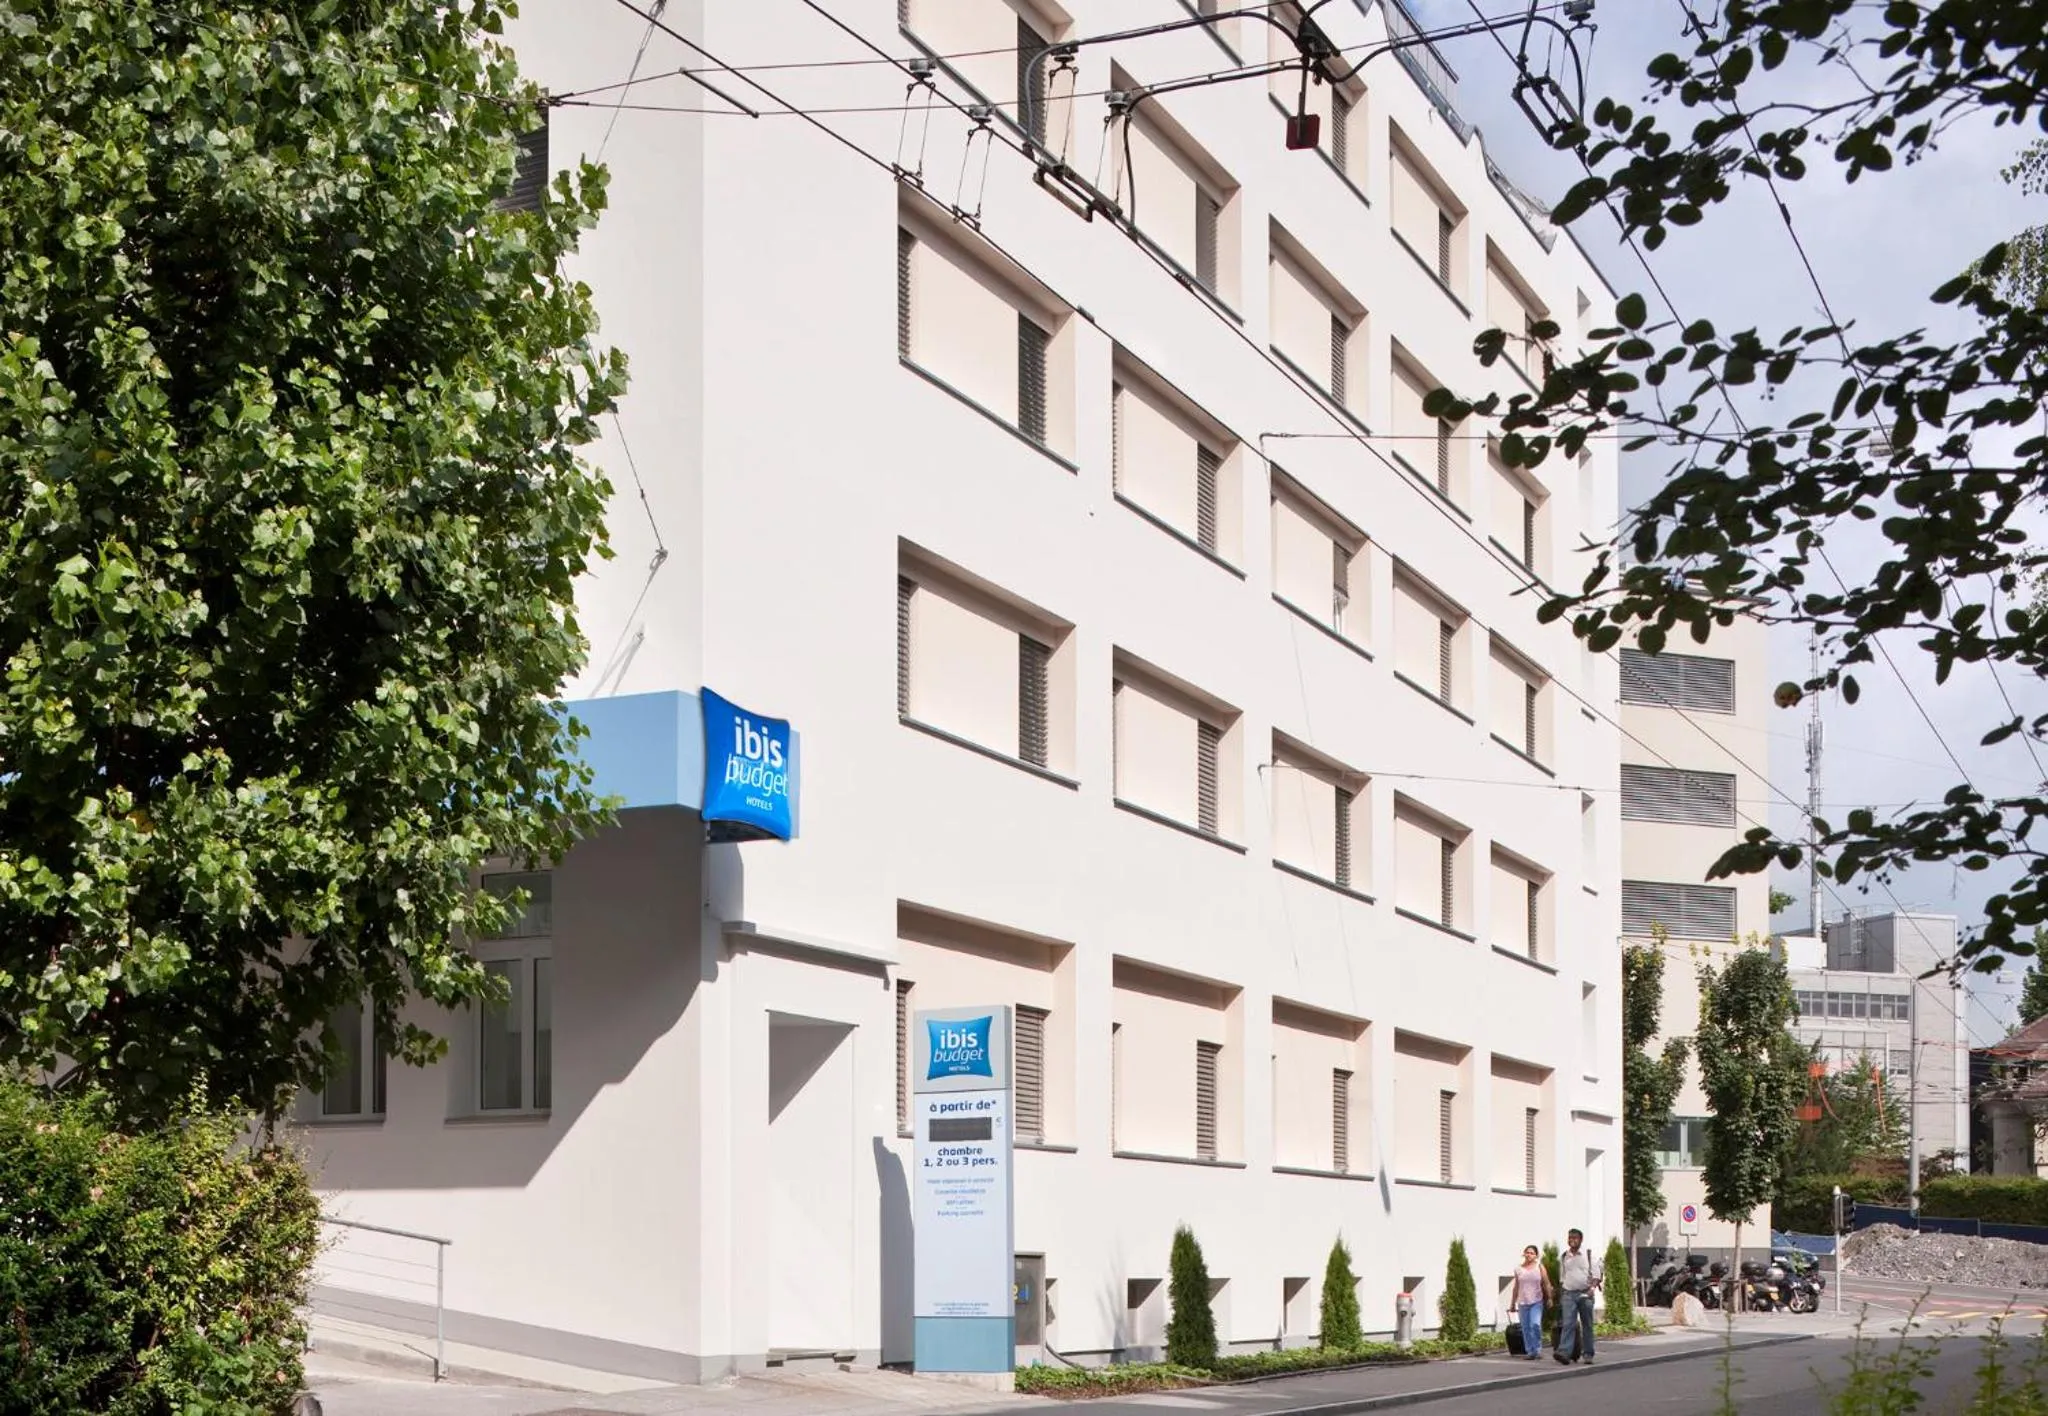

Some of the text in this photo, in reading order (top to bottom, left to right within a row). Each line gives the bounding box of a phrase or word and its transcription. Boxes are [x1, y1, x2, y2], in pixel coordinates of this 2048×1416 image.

[735, 716, 783, 768] ibis
[725, 753, 789, 797] budget
[746, 796, 773, 810] HOTELS
[940, 1028, 978, 1049] ibis
[933, 1047, 984, 1065] budget
[940, 1101, 973, 1114] partir
[938, 1146, 983, 1156] chambre
[923, 1157, 998, 1168] 1, 2 ou 3 pers.
